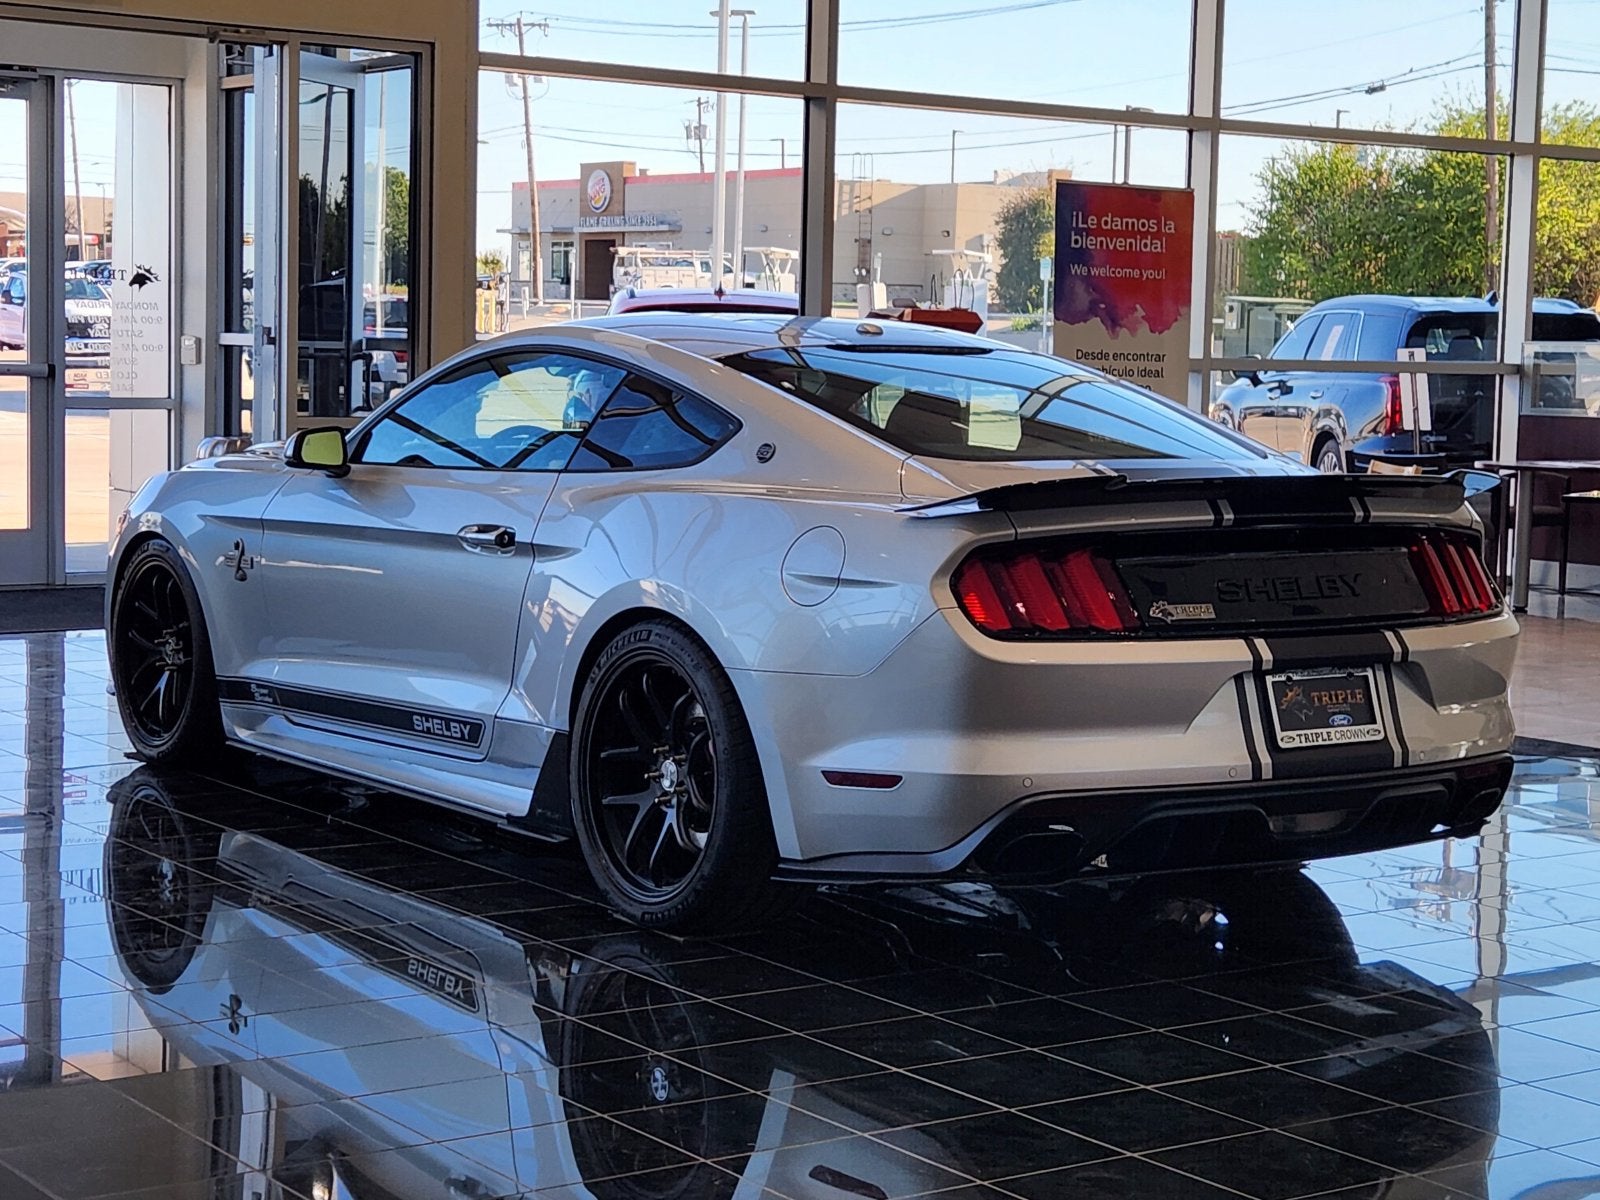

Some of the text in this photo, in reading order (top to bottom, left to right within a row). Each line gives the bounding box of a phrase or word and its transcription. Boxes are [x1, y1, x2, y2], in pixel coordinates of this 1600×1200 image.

[580, 216, 598, 227] FLAME
[626, 214, 641, 226] SINCE
[1101, 213, 1157, 232] damos
[1161, 215, 1175, 233] la
[1071, 232, 1166, 253] bienvenida!
[1070, 263, 1166, 280] We welcome you!
[1076, 349, 1166, 362] Desde encontrar
[1096, 365, 1164, 378] hículo ideal
[1216, 573, 1362, 603] SHELBY
[1174, 605, 1213, 614] TRIPLE
[599, 629, 651, 667] MICHELIN
[1310, 689, 1364, 706] TRIPLE
[412, 715, 472, 741] SHELBY
[1296, 731, 1333, 744] TRIPLE
[1334, 728, 1367, 741] CROWN
